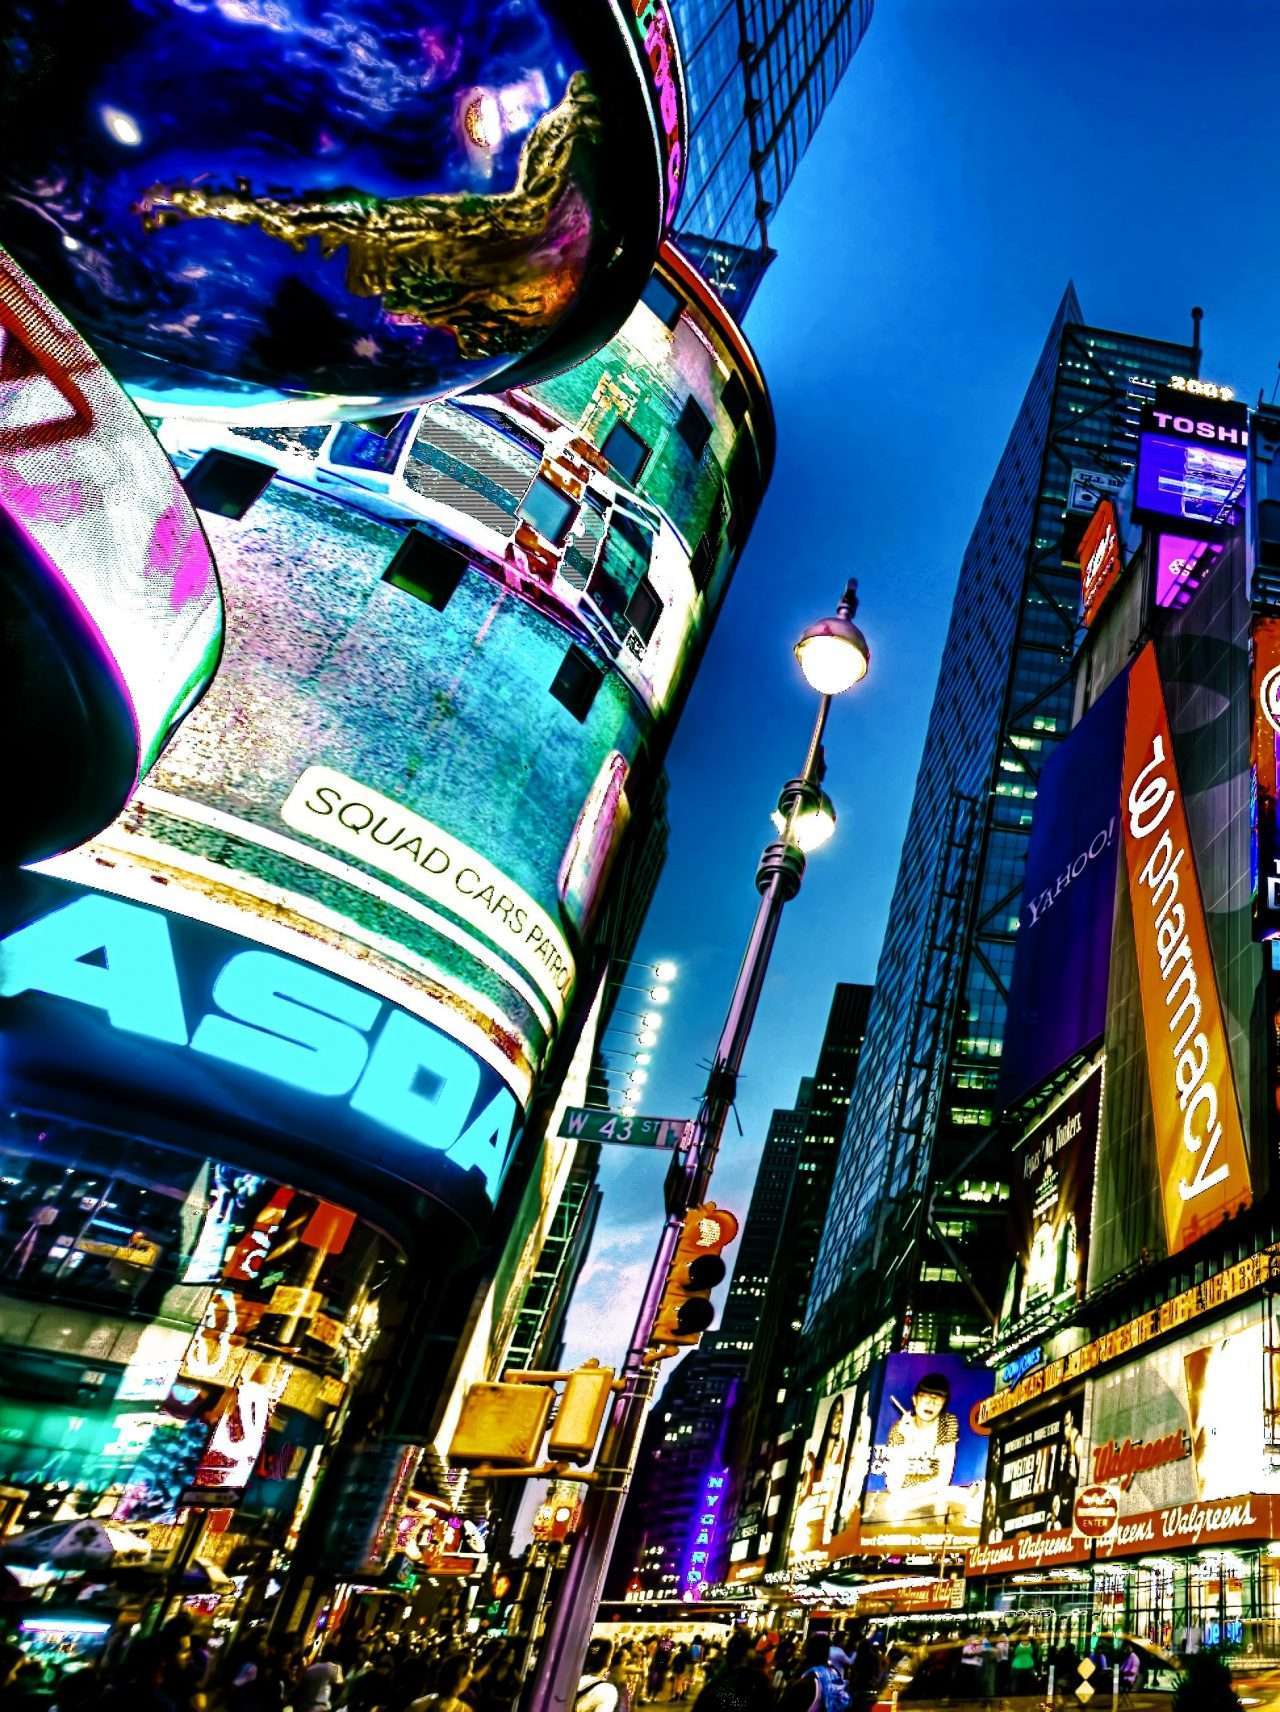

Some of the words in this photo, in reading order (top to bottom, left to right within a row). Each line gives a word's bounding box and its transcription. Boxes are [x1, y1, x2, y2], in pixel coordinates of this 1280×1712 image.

[305, 787, 451, 875] SQUAD
[455, 868, 528, 934] CARS
[525, 924, 573, 1000] PATROL
[1026, 818, 1115, 926] YAHOO!
[1139, 829, 1230, 1200] pharmacy
[567, 1111, 590, 1136] W
[598, 1116, 634, 1141] 43
[641, 1121, 660, 1133] ST
[1093, 1428, 1187, 1491] Walgreens
[969, 1543, 1015, 1574] Walgreens
[1018, 1534, 1074, 1568] Walgreens
[1160, 1500, 1257, 1543] Walgreens
[1083, 1518, 1109, 1528] ENTER
